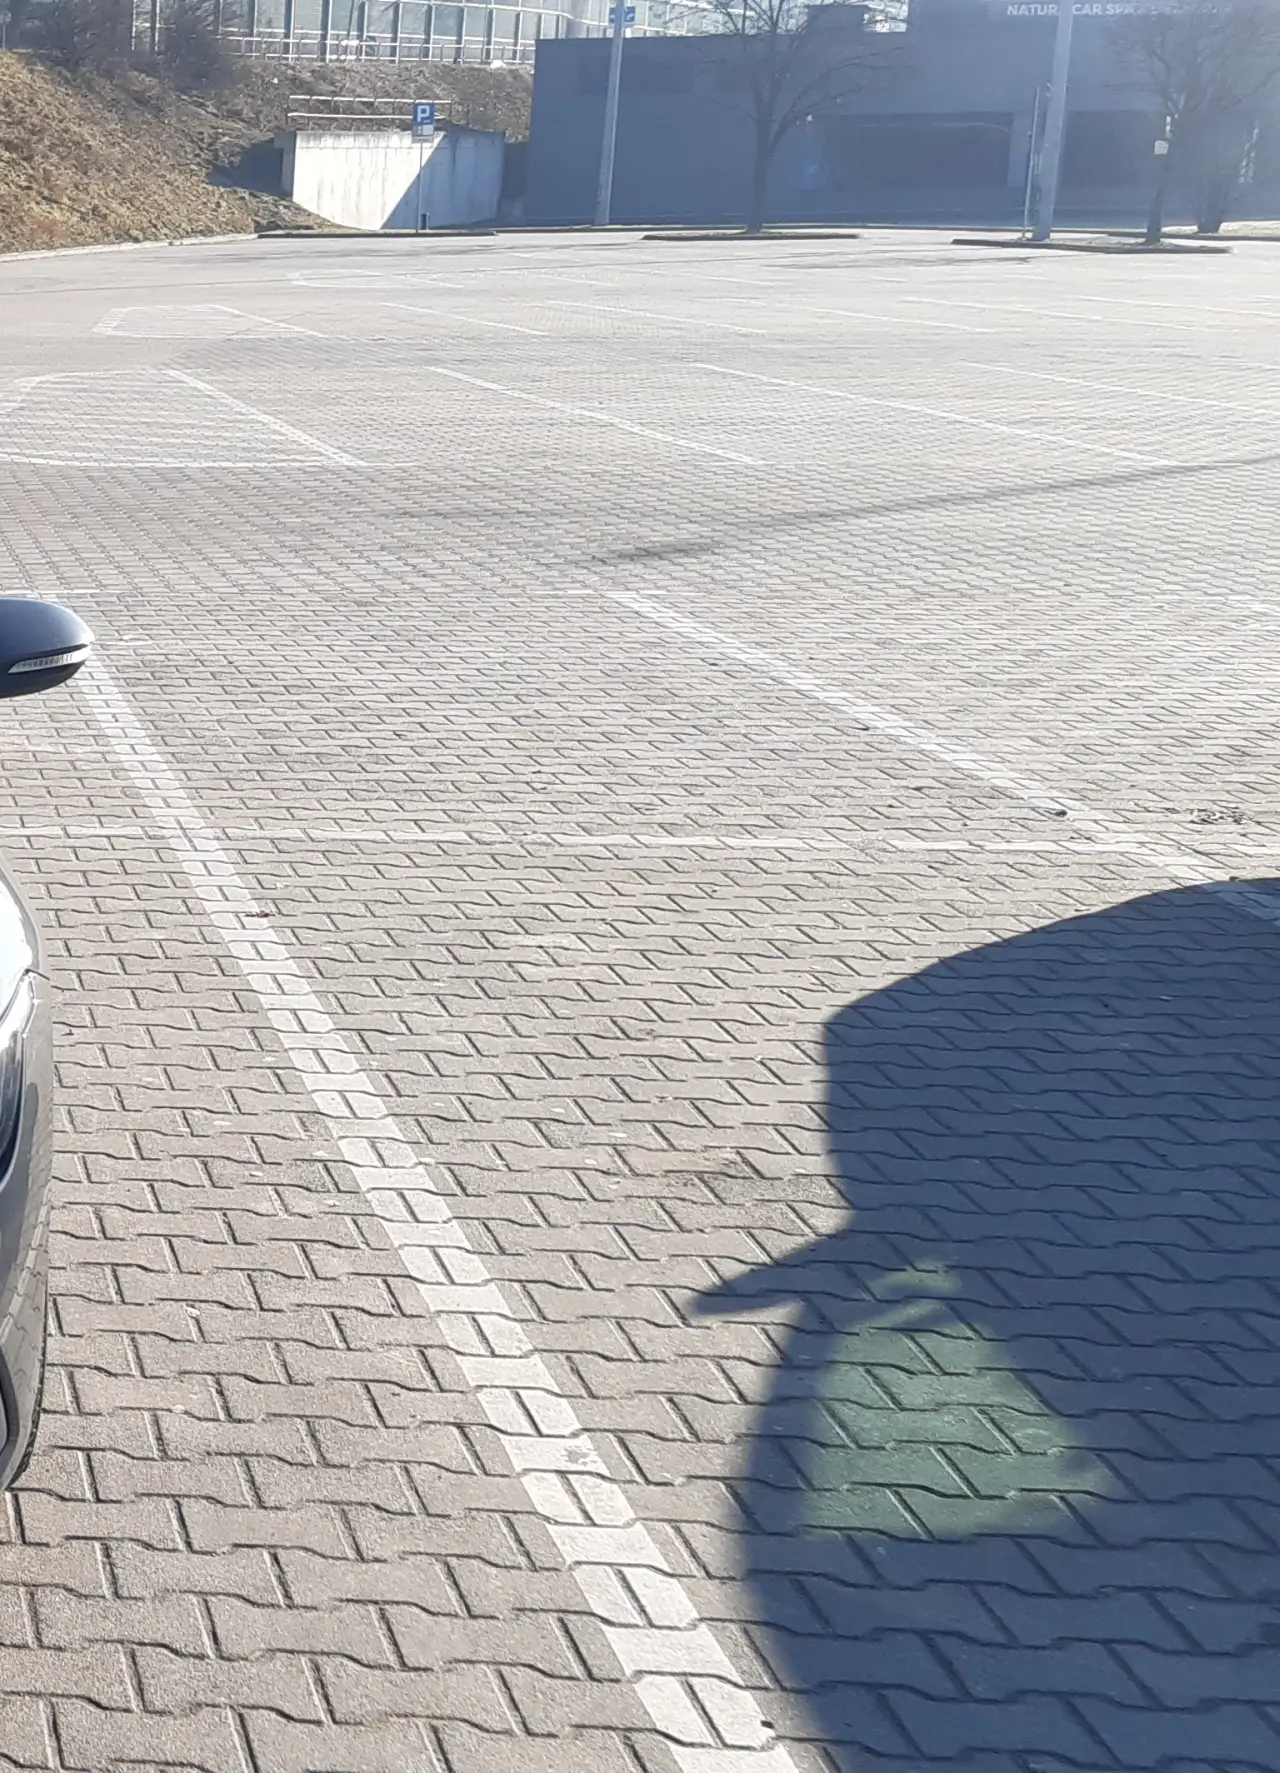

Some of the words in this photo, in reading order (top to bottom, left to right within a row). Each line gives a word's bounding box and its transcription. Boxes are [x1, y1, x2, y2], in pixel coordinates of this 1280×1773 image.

[1006, 4, 1061, 16] NATUR
[1072, 4, 1102, 16] CAR
[417, 105, 430, 122] P
